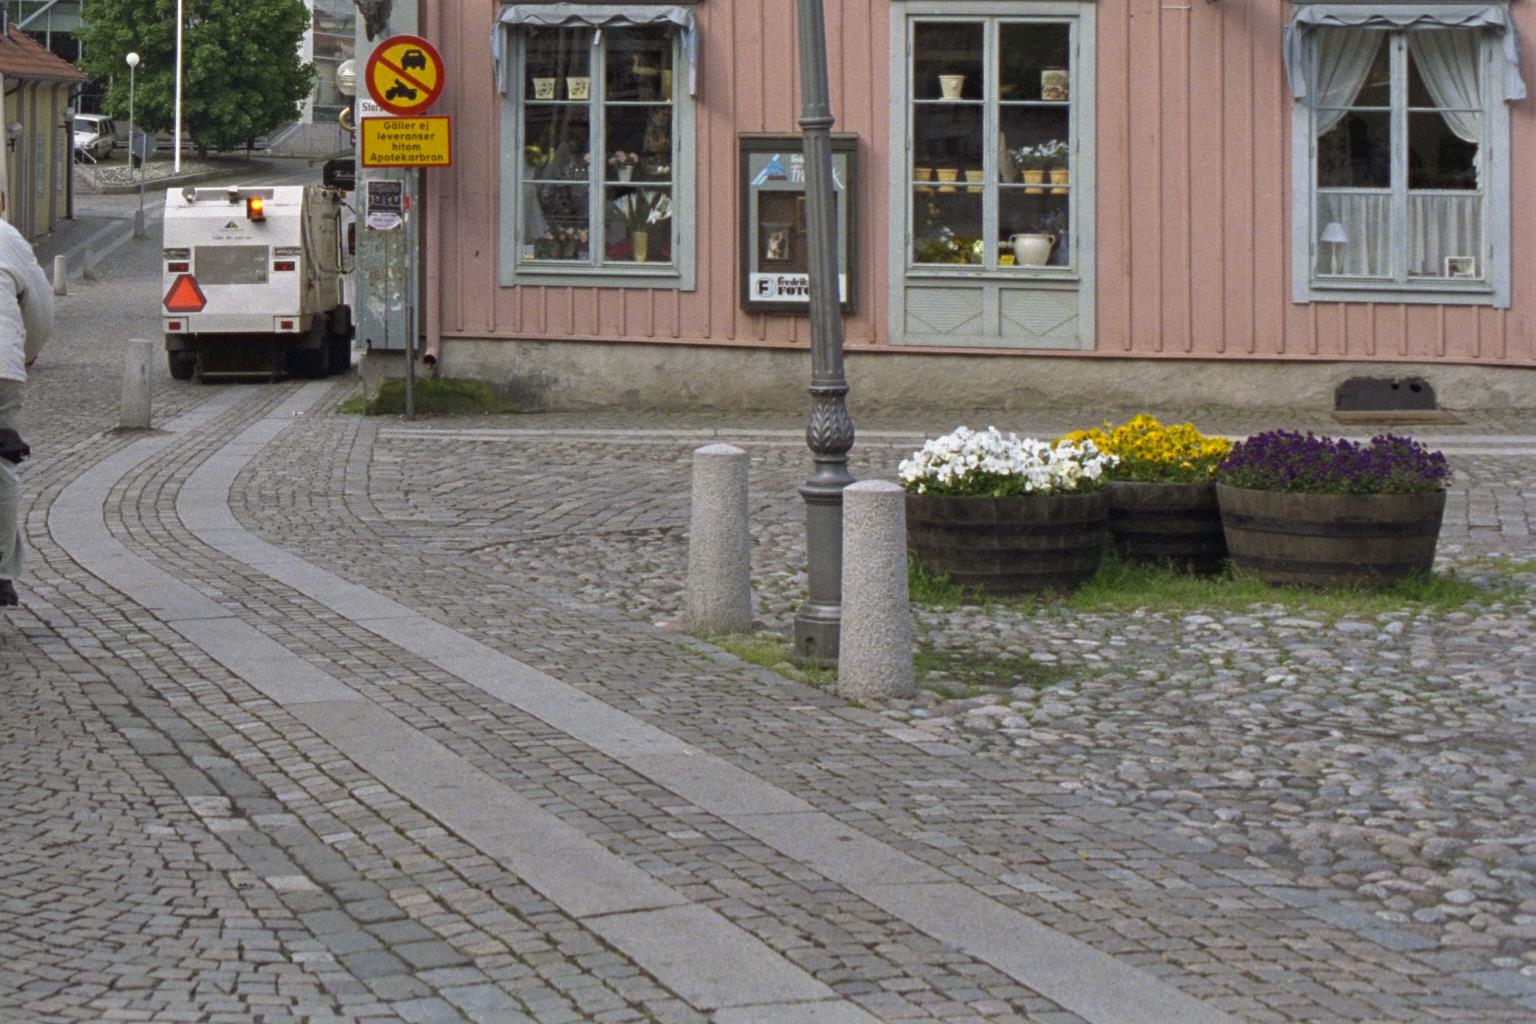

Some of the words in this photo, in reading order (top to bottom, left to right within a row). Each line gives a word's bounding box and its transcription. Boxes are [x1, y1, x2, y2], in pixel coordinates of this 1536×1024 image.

[384, 121, 415, 130] Gäller
[419, 122, 429, 131] ej
[392, 143, 420, 151] hitom
[370, 153, 443, 162] Apotekarbron
